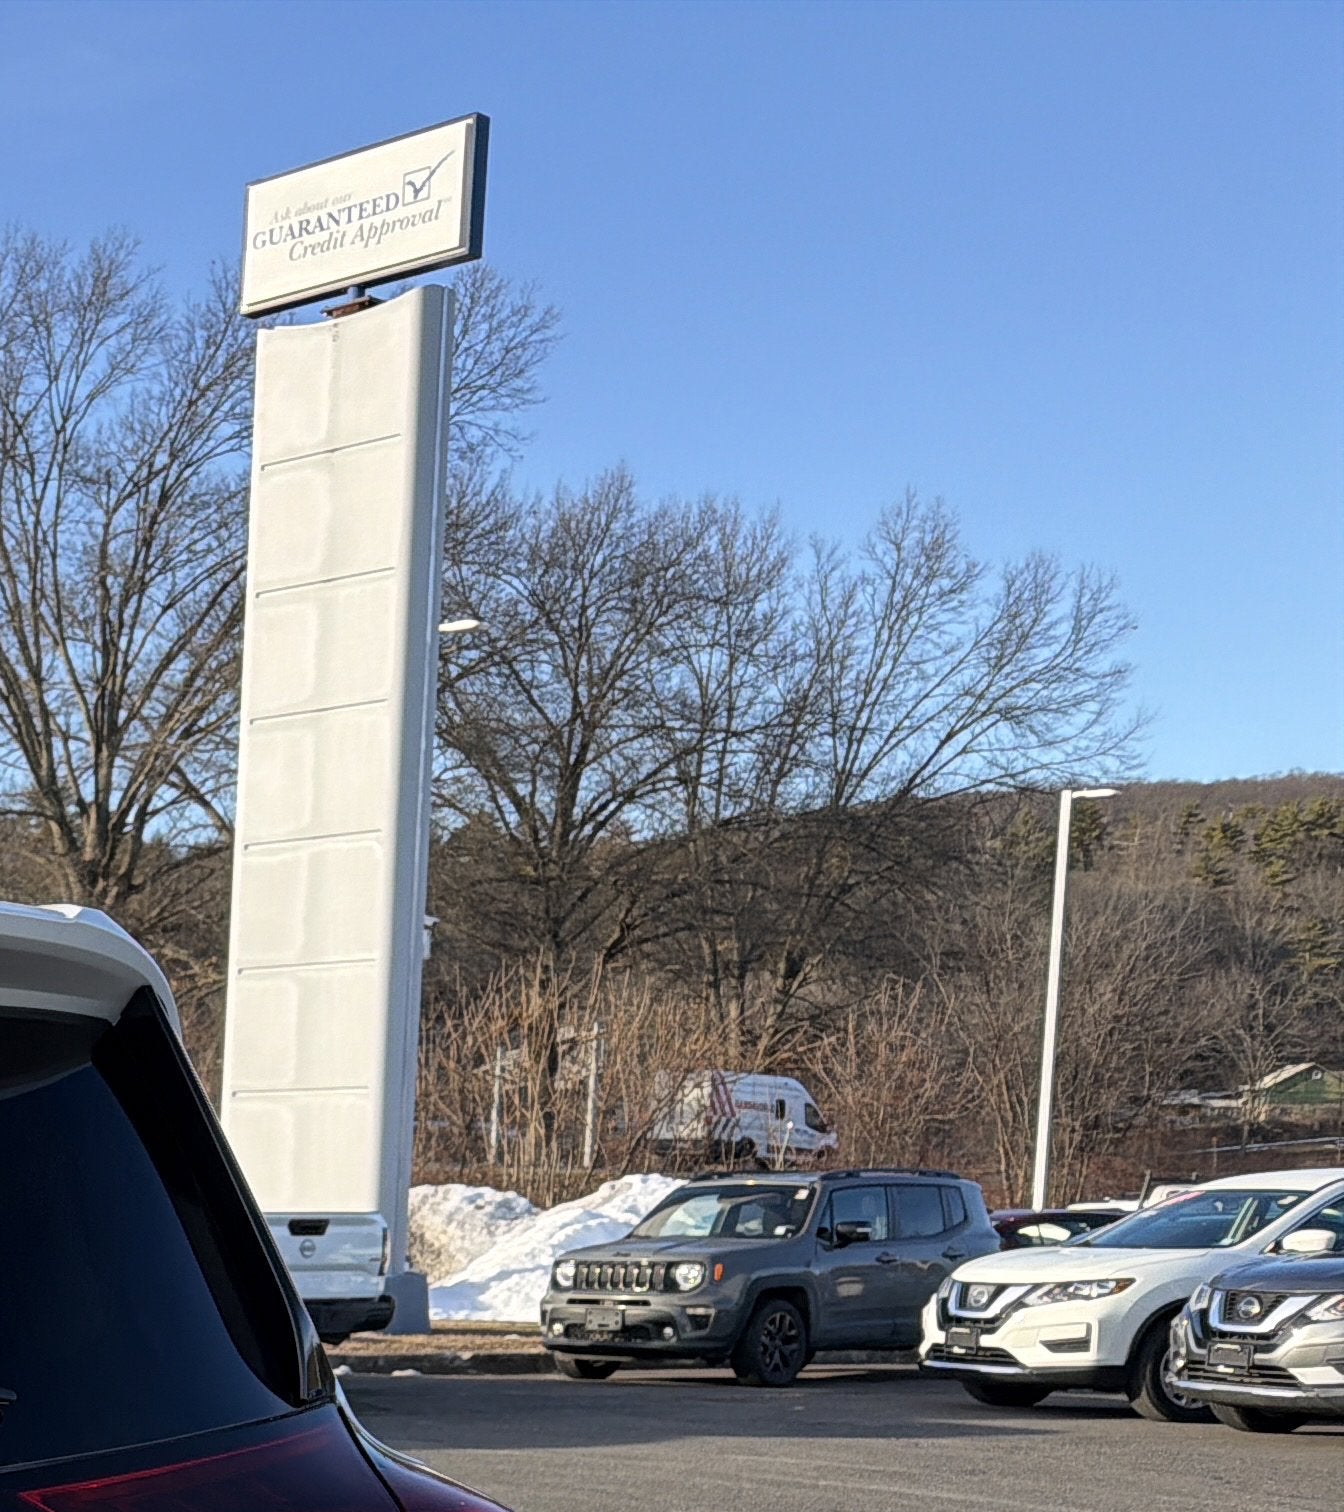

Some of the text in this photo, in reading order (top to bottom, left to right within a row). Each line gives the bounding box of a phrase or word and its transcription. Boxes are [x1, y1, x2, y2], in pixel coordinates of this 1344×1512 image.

[252, 191, 400, 250] GUARANTEED
[288, 199, 442, 262] Credit Approval
[295, 197, 330, 218] about
[331, 192, 353, 206] our
